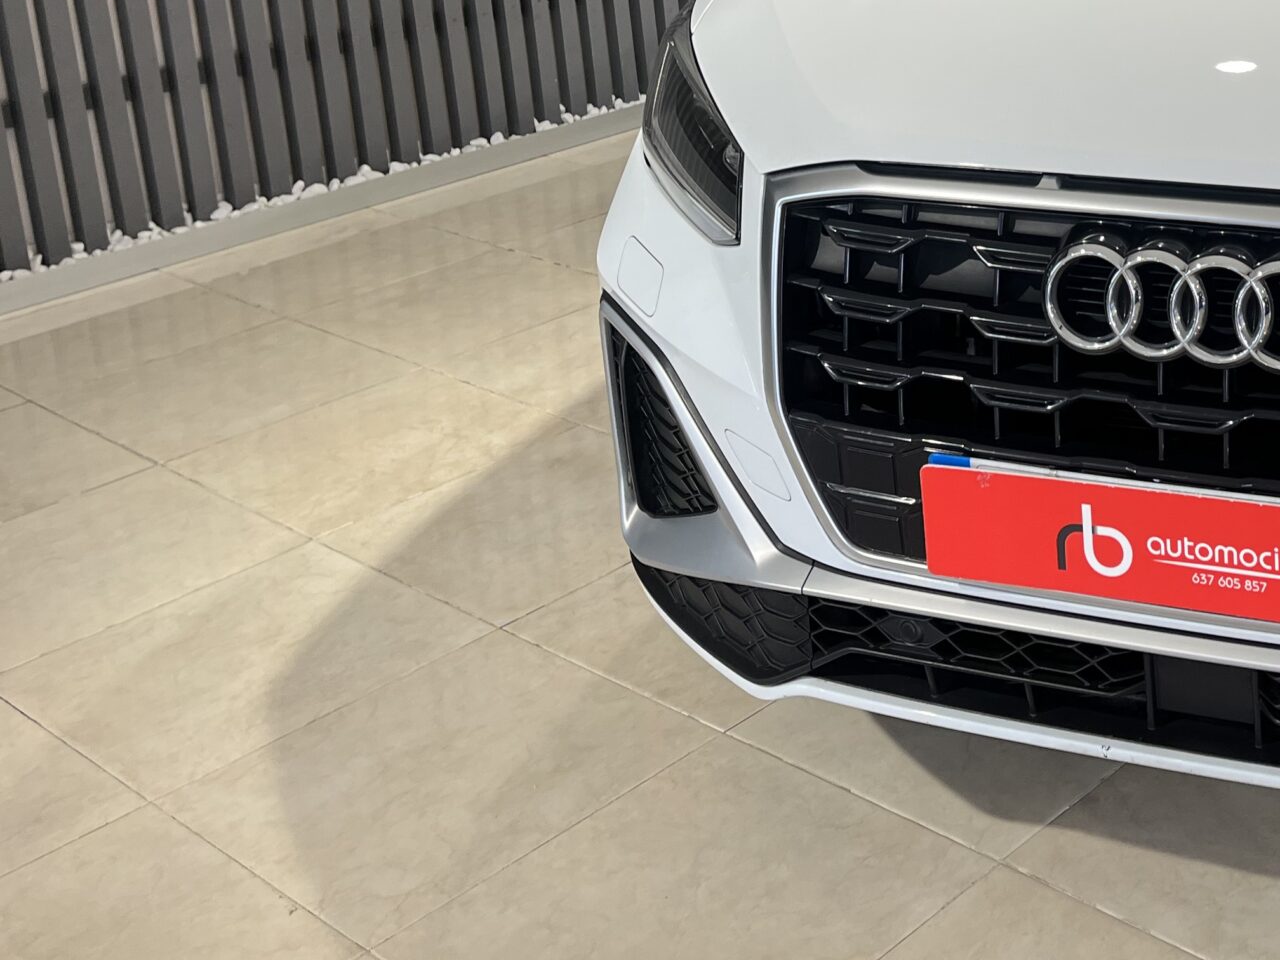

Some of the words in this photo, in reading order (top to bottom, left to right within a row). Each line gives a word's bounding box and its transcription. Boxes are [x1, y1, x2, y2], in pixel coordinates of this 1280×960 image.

[1056, 503, 1133, 577] rb
[1191, 573, 1214, 585] 637
[1218, 576, 1241, 589] 605
[1244, 579, 1267, 593] 857
